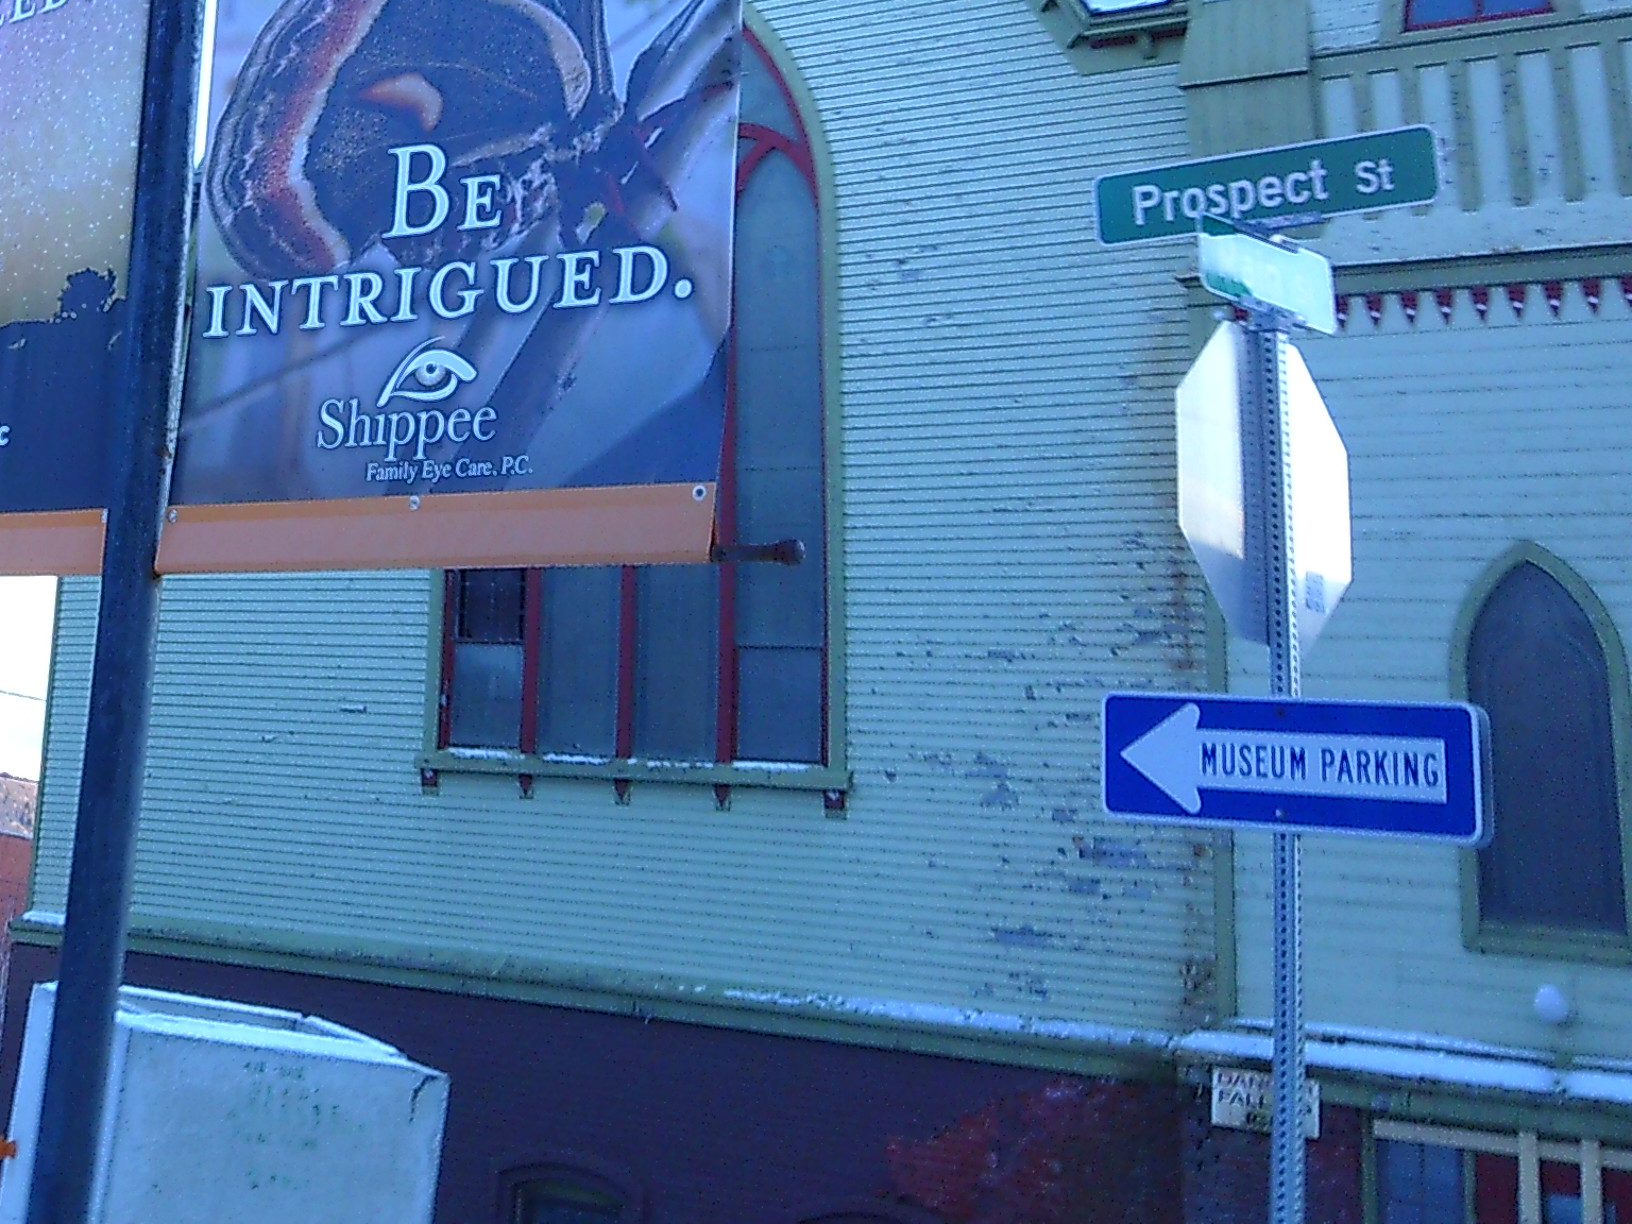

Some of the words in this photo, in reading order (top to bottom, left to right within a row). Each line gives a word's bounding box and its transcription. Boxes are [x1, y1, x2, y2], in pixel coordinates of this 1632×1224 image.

[382, 143, 501, 240] BE
[1131, 158, 1329, 226] Prospect
[1355, 158, 1395, 193] St
[203, 245, 694, 339] INTRIGUED.
[316, 399, 497, 462] Shippee
[367, 460, 418, 484] Family
[421, 459, 452, 483] Eye
[501, 455, 534, 475] P.C.
[1201, 742, 1307, 780] MUSEUM
[1320, 749, 1439, 787] PARKING
